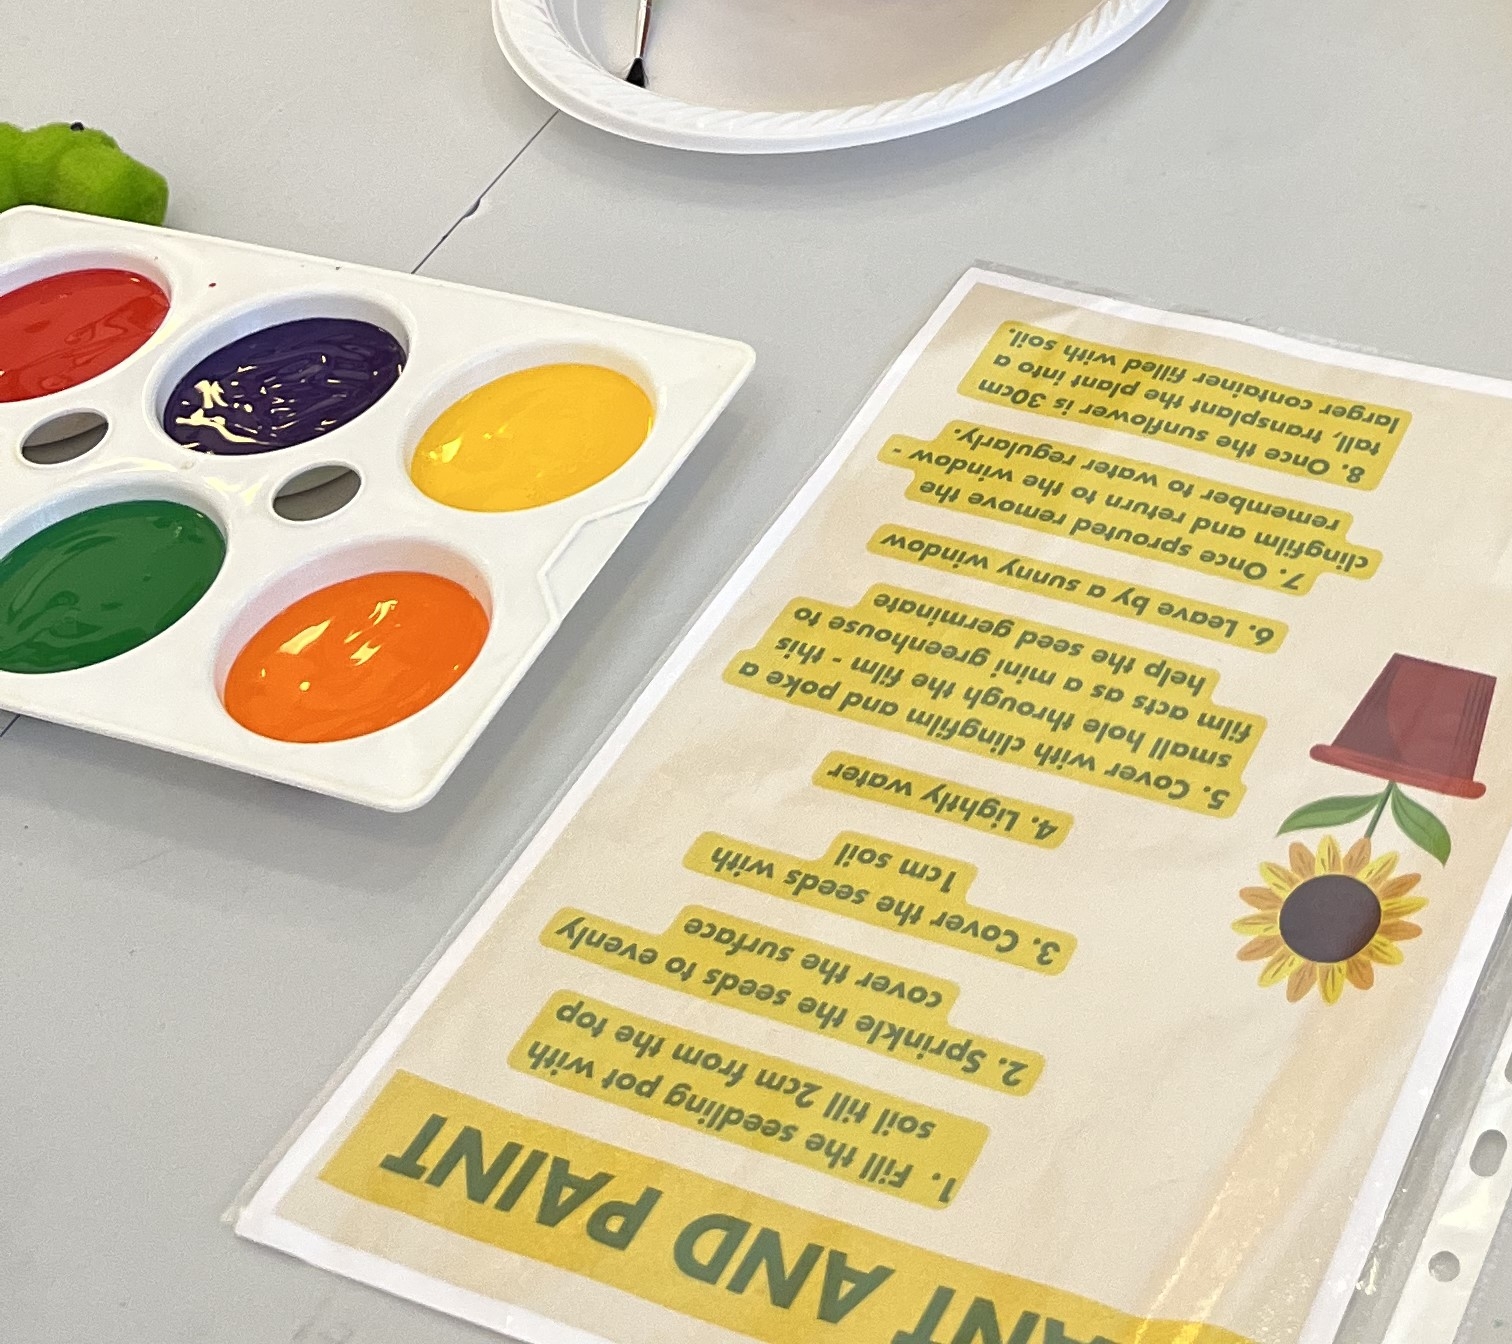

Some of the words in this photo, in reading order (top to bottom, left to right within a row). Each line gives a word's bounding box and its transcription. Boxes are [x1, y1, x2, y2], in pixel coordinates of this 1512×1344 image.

[1007, 327, 1058, 351] soil.
[1062, 343, 1116, 367] with
[991, 352, 1012, 367] a
[1016, 360, 1067, 387] into
[1119, 357, 1188, 384] filled
[977, 377, 1047, 409] 30cm
[1069, 373, 1141, 399] plant
[1142, 387, 1185, 410] the
[1190, 371, 1313, 411] container
[1051, 396, 1075, 416] is
[1077, 402, 1209, 442] sunflower
[1187, 398, 1323, 444] transplant
[1317, 402, 1401, 435] larger
[953, 426, 1077, 467] regularly.
[1214, 434, 1258, 459] the
[1331, 430, 1381, 456] tall,
[906, 448, 1013, 483] window
[1079, 458, 1158, 487] water
[1263, 446, 1331, 476] Once
[1341, 462, 1366, 484] 8.
[918, 480, 961, 504] the
[1021, 473, 1065, 498] the
[1069, 485, 1098, 505] to
[1166, 478, 1195, 498] to
[966, 491, 1068, 526] remove
[1103, 493, 1187, 524] return
[1198, 488, 1341, 532] remember
[1067, 516, 1193, 557] sprouted
[1187, 515, 1247, 540] and
[878, 532, 989, 570] window
[1198, 548, 1268, 581] Once
[1252, 530, 1369, 573] clingfilm
[995, 557, 1082, 592] sunny
[1084, 582, 1107, 599] a
[1278, 567, 1305, 591] 7.
[792, 606, 823, 628] to
[872, 592, 1016, 638] germinate
[1109, 586, 1151, 616] by
[1156, 601, 1239, 639] Leave
[1247, 623, 1275, 647] 6.
[773, 636, 826, 665] this
[827, 614, 991, 667] greenhouse
[1012, 628, 1085, 657] seed
[737, 660, 760, 677] a
[849, 655, 905, 688] film
[988, 657, 1057, 686] mini
[1090, 648, 1137, 676] the
[1142, 658, 1207, 697] help
[764, 669, 843, 701] poke
[909, 672, 957, 701] the
[1061, 675, 1084, 693] a
[1088, 683, 1125, 703] as
[836, 690, 899, 717] and
[961, 685, 1076, 733] through
[1130, 693, 1189, 721] acts
[904, 706, 1026, 756] clingfilm
[1081, 717, 1147, 754] hole
[1195, 711, 1253, 744] film
[1032, 741, 1096, 772] with
[1146, 736, 1233, 768] small
[825, 762, 912, 797] water
[1102, 761, 1191, 801] Cover
[918, 782, 1021, 833] Lightly
[1201, 784, 1231, 811] 5.
[1030, 815, 1059, 841] 4.
[709, 845, 775, 879] with
[832, 841, 894, 869] soil
[781, 868, 871, 905] seeds
[897, 857, 957, 894] 1cm
[874, 894, 925, 927] the
[553, 915, 659, 966] evenly
[682, 916, 796, 962] surface
[928, 910, 1019, 954] Cover
[1031, 936, 1061, 966] 3.
[663, 955, 698, 983] to
[799, 952, 851, 986] the
[701, 967, 792, 1006] seeds
[853, 970, 943, 1008] cover
[554, 999, 609, 1039] top
[796, 995, 849, 1030] the
[613, 1024, 666, 1059] the
[854, 1013, 988, 1074] Sprinkle
[526, 1039, 595, 1079] with
[670, 1042, 749, 1088] from
[997, 1056, 1029, 1087] 2.
[600, 1067, 664, 1099] pot
[753, 1067, 823, 1109] 2cm
[661, 1081, 799, 1143] seedling
[821, 1090, 871, 1124] till
[870, 1107, 936, 1139] soil
[803, 1131, 858, 1170] the
[379, 1113, 664, 1251] PAINT
[857, 1151, 914, 1189] Fill
[930, 1171, 957, 1204] 1.
[673, 1213, 896, 1324] AND
